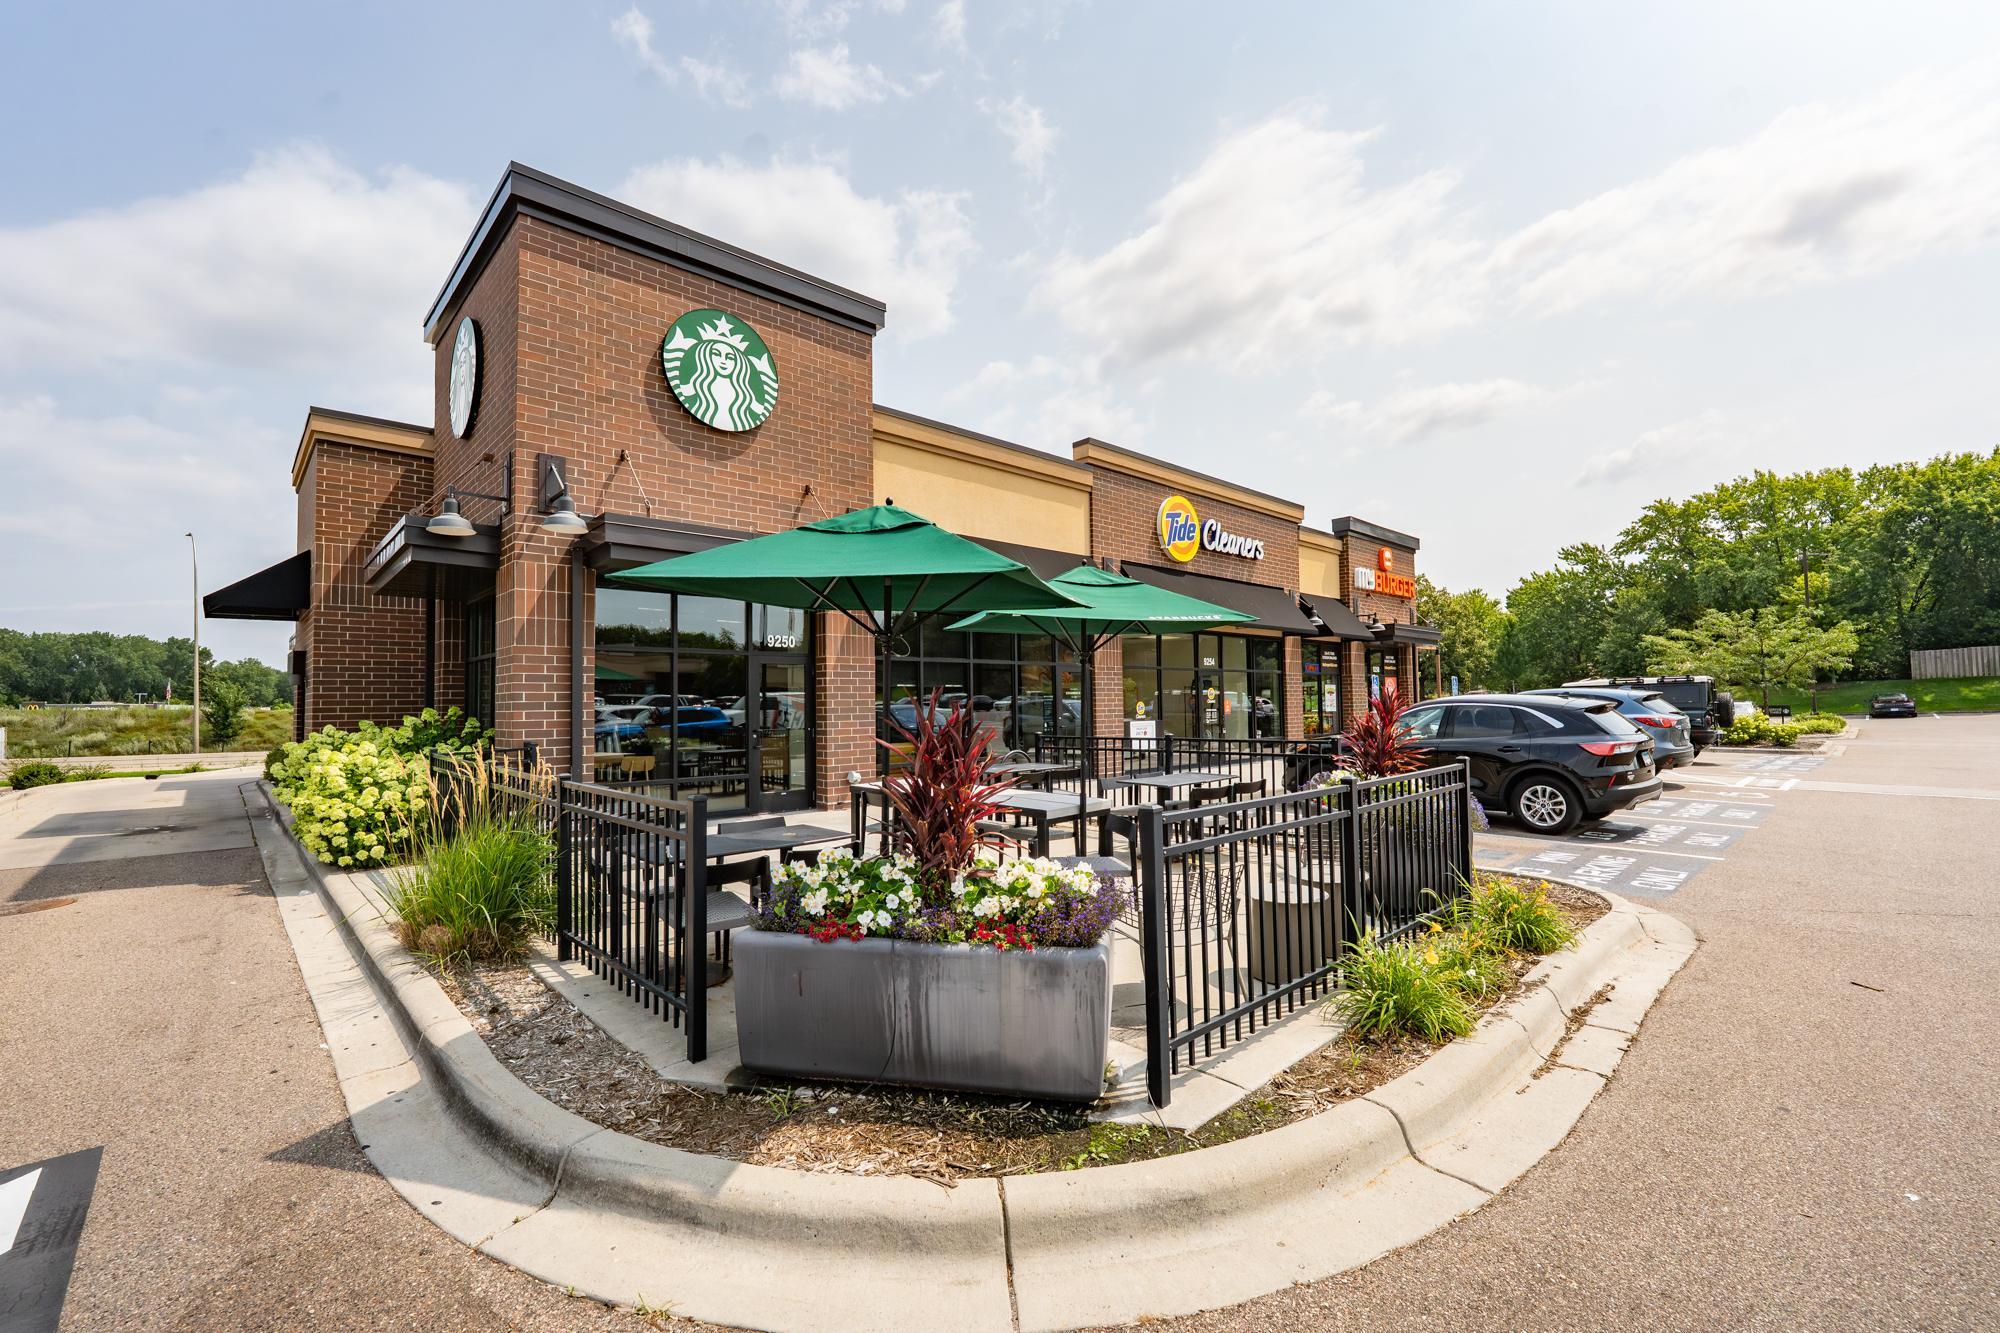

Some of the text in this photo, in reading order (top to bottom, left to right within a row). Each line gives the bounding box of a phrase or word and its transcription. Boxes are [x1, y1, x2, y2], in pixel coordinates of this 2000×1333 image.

[1165, 512, 1264, 560] Tide Cleaners
[767, 634, 796, 648] 9250
[1203, 657, 1215, 666] 9254
[1629, 866, 1689, 890] ONLY
